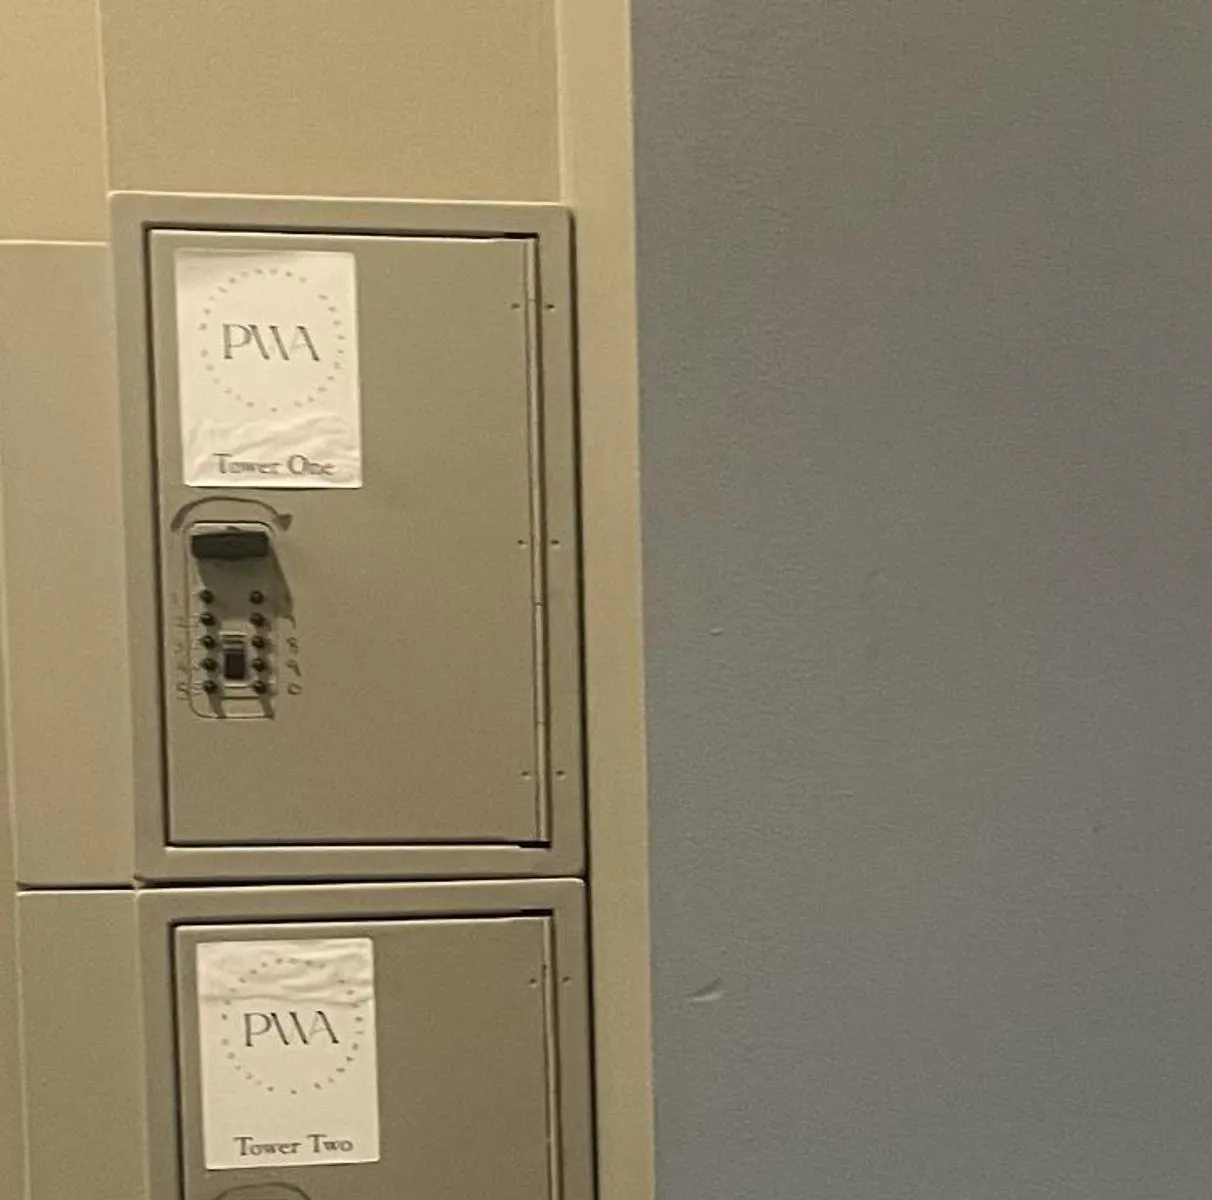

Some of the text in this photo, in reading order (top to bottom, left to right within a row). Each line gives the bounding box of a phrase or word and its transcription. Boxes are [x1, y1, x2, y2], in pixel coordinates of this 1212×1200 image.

[222, 323, 321, 362] PWA
[213, 453, 281, 475] Tower
[243, 1010, 340, 1047] PWA
[233, 1134, 354, 1157] Tower Two
